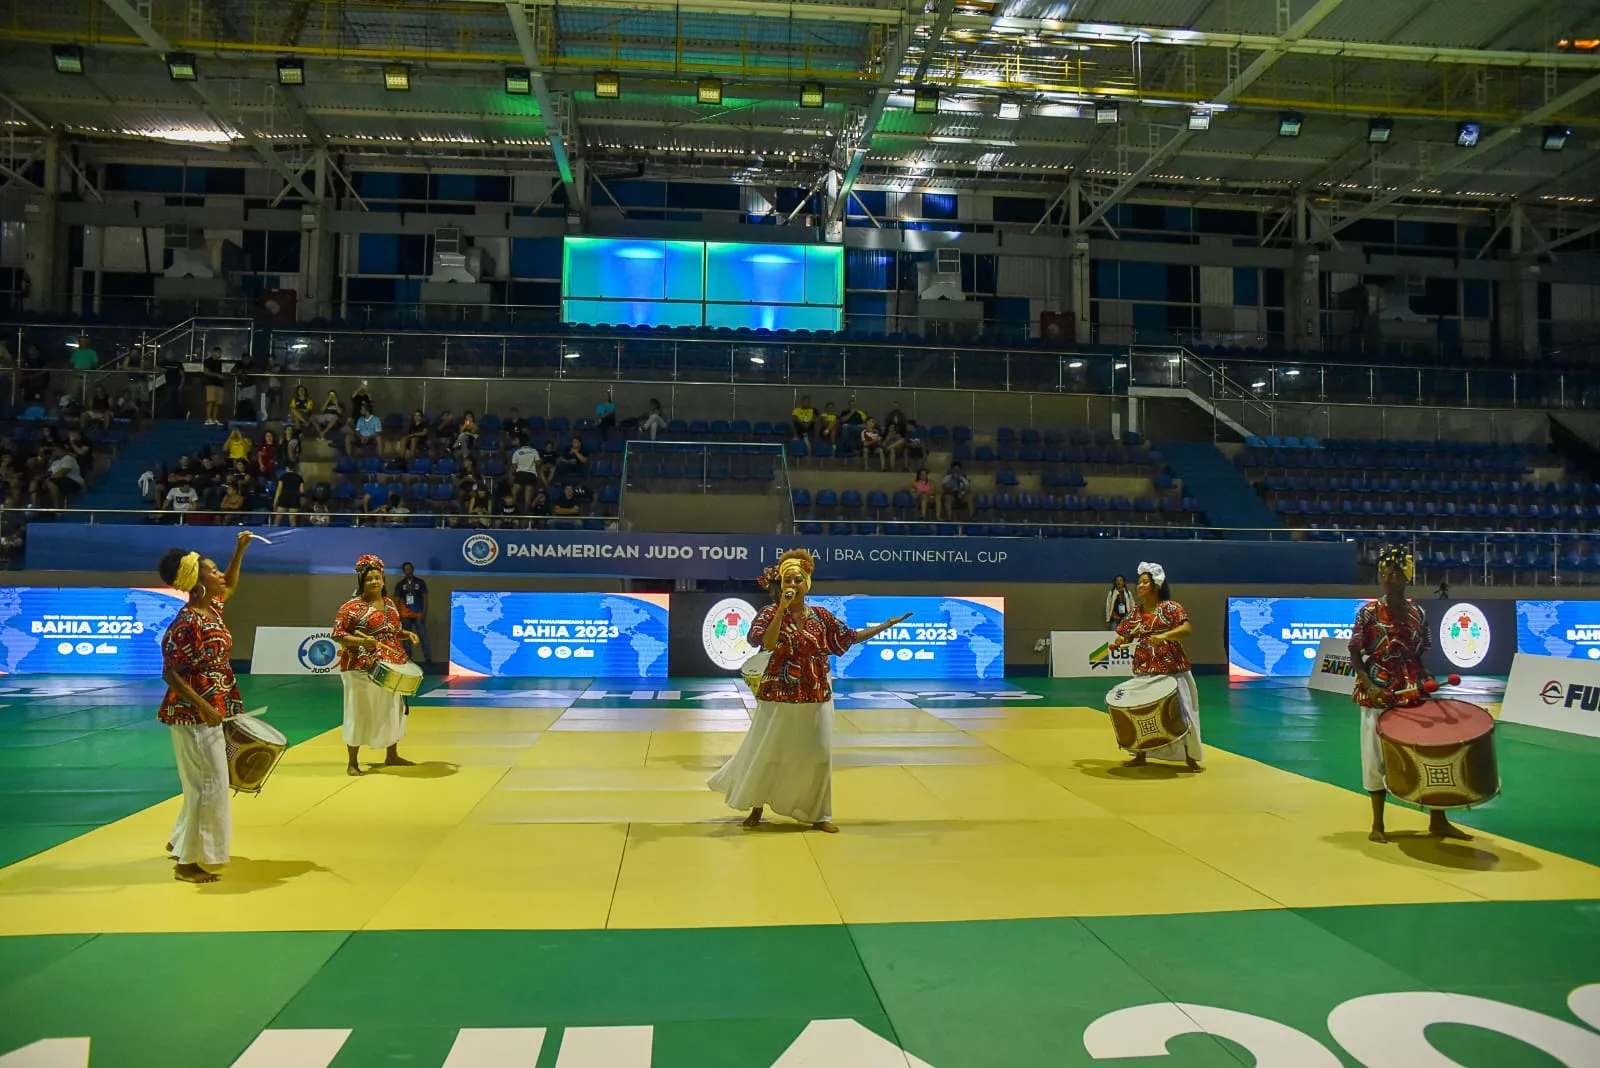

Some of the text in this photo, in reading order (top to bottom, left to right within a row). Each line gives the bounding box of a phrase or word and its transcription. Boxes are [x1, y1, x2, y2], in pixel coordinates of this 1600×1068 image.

[506, 543, 1008, 563] PANAMERICAN JUDO TOUR BIA BRA CONTINENTAL CUP
[31, 620, 144, 634] BAHIA 2023
[512, 625, 619, 638] BAHIA 2023
[310, 632, 333, 640] PANA
[915, 628, 958, 641] 2023
[1281, 628, 1353, 640] BAHIA 20
[1564, 683, 1600, 712] FU
